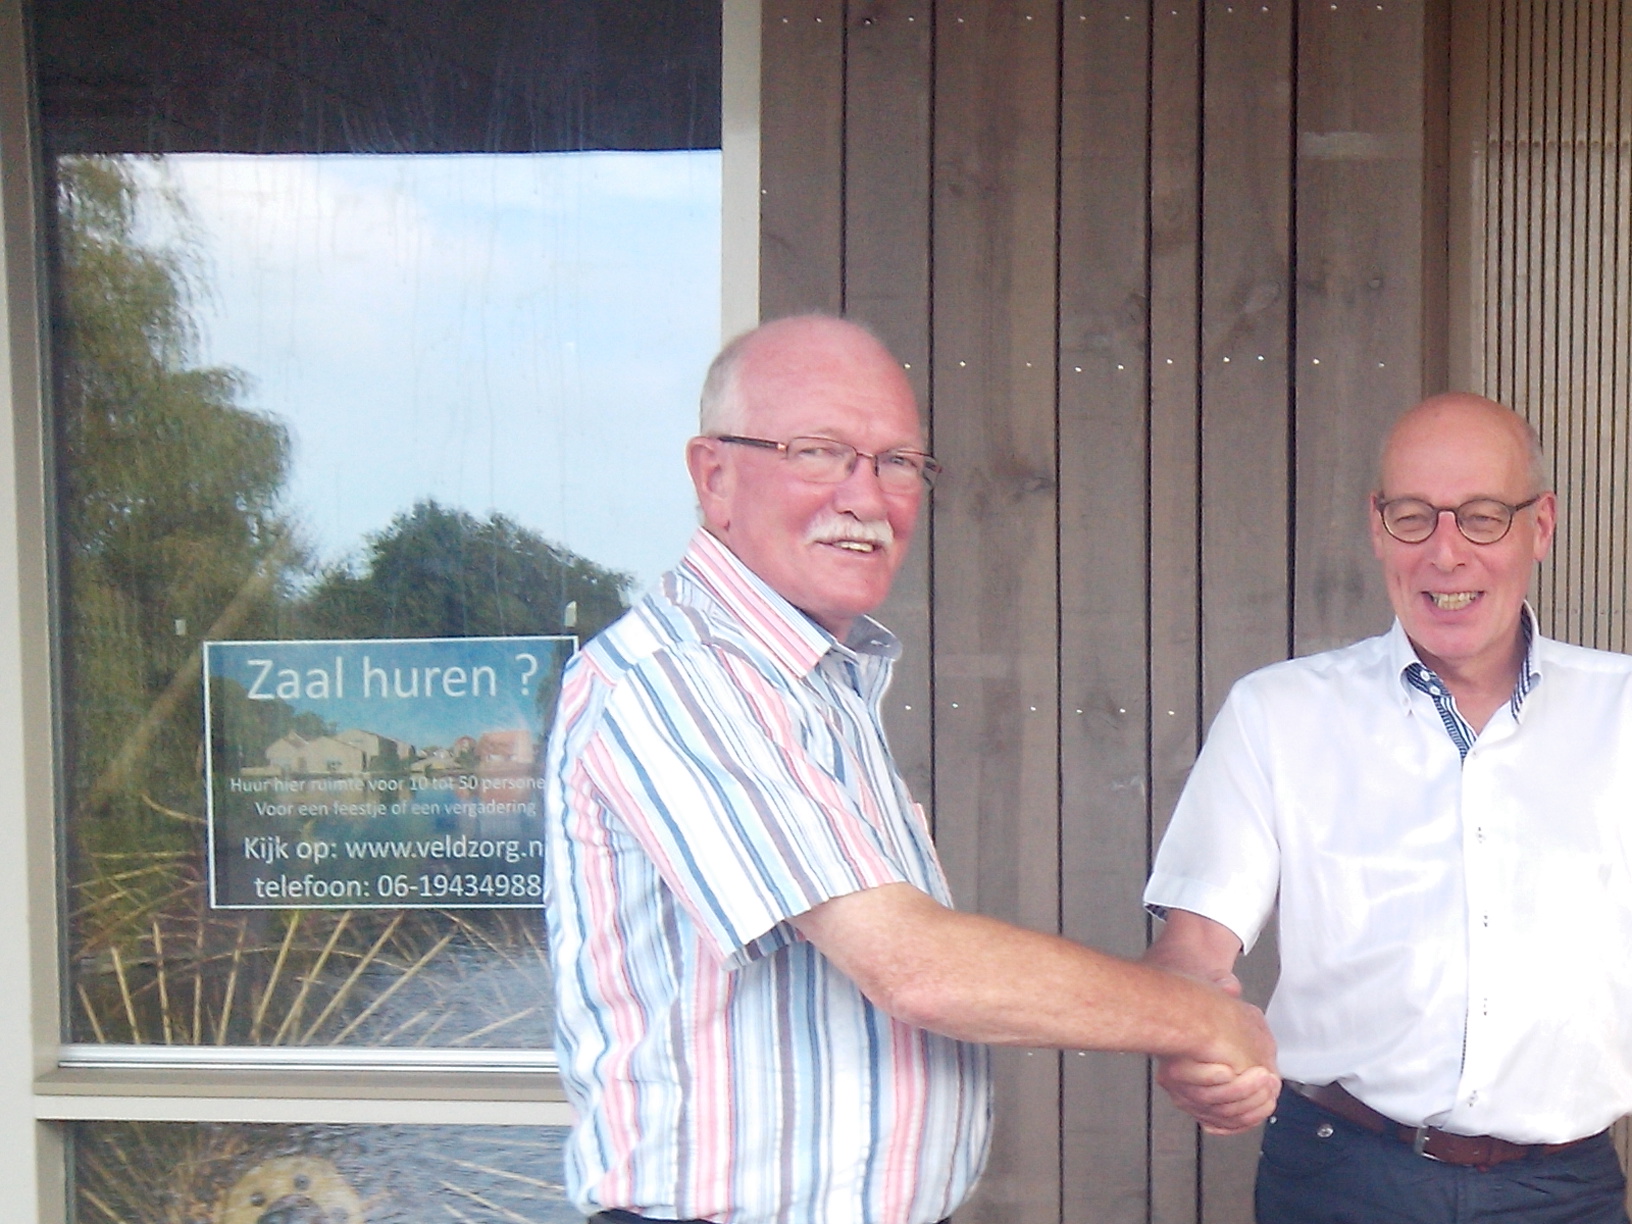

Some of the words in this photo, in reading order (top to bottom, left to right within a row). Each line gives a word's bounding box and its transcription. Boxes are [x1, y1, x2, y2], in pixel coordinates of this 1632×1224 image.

[247, 657, 343, 700] Zaal
[363, 656, 497, 698] huren
[514, 653, 538, 696] ?
[230, 778, 270, 792] Huur
[274, 777, 305, 792] hier
[311, 777, 364, 790] ruimte
[368, 779, 403, 791] voor
[410, 778, 428, 791] 10
[431, 778, 454, 790] tot
[459, 776, 478, 790] 50
[482, 778, 545, 792] persone
[255, 802, 294, 816] Voor
[298, 804, 329, 816] een
[333, 801, 387, 818] feestje
[391, 801, 407, 815] of
[411, 803, 440, 815] een
[445, 800, 537, 817] vergadering
[244, 836, 289, 864] Kijk
[296, 841, 337, 864] op:
[345, 834, 544, 863] www.veldzorg.n
[254, 874, 370, 898] telefoon:
[378, 873, 542, 897] 06-19434988
